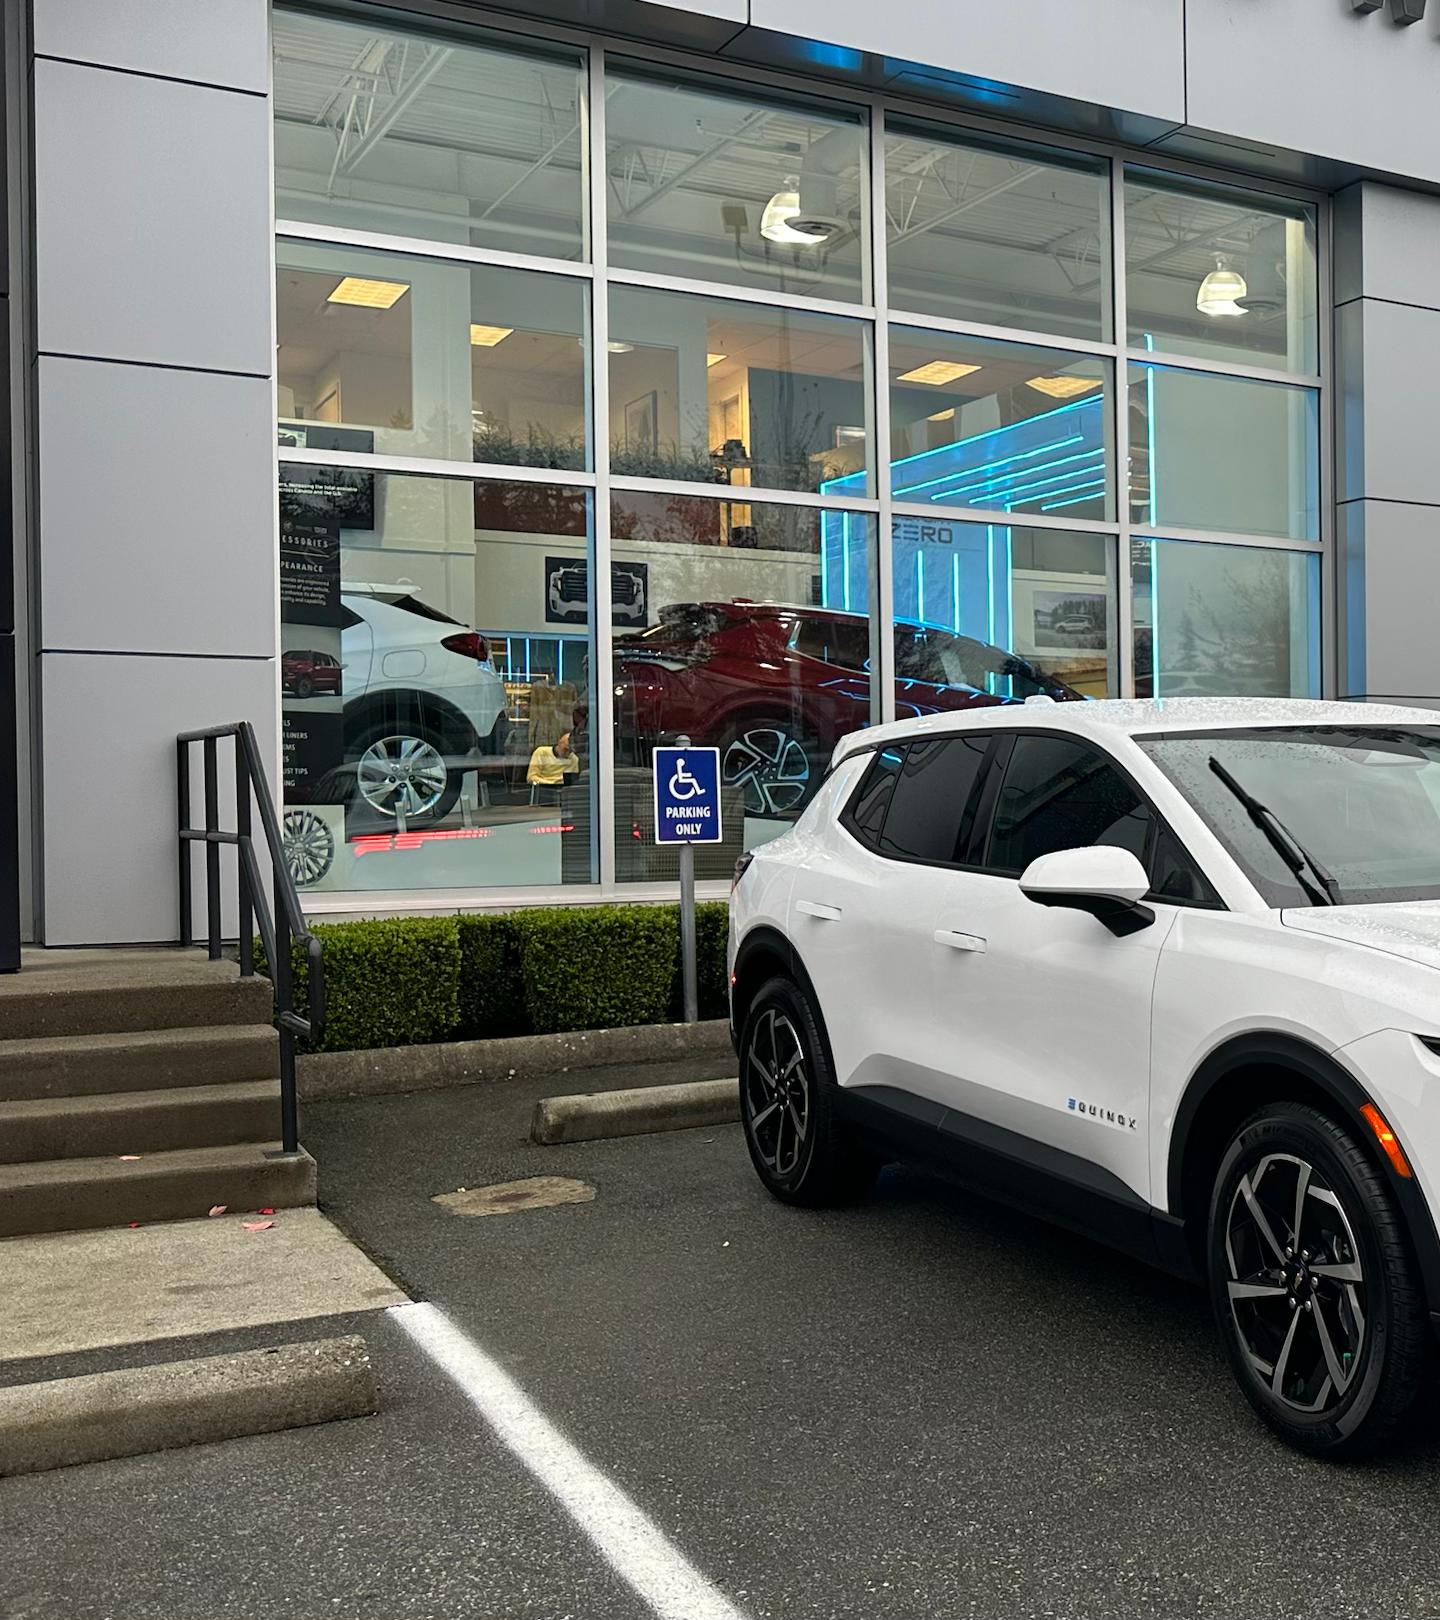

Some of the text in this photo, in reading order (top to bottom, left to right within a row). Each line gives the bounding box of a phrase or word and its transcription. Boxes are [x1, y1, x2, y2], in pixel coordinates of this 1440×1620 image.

[892, 522, 953, 544] ZERO
[665, 806, 711, 819] PARKING
[675, 823, 702, 835] ONLY
[1067, 1098, 1137, 1130] EQUINOX
